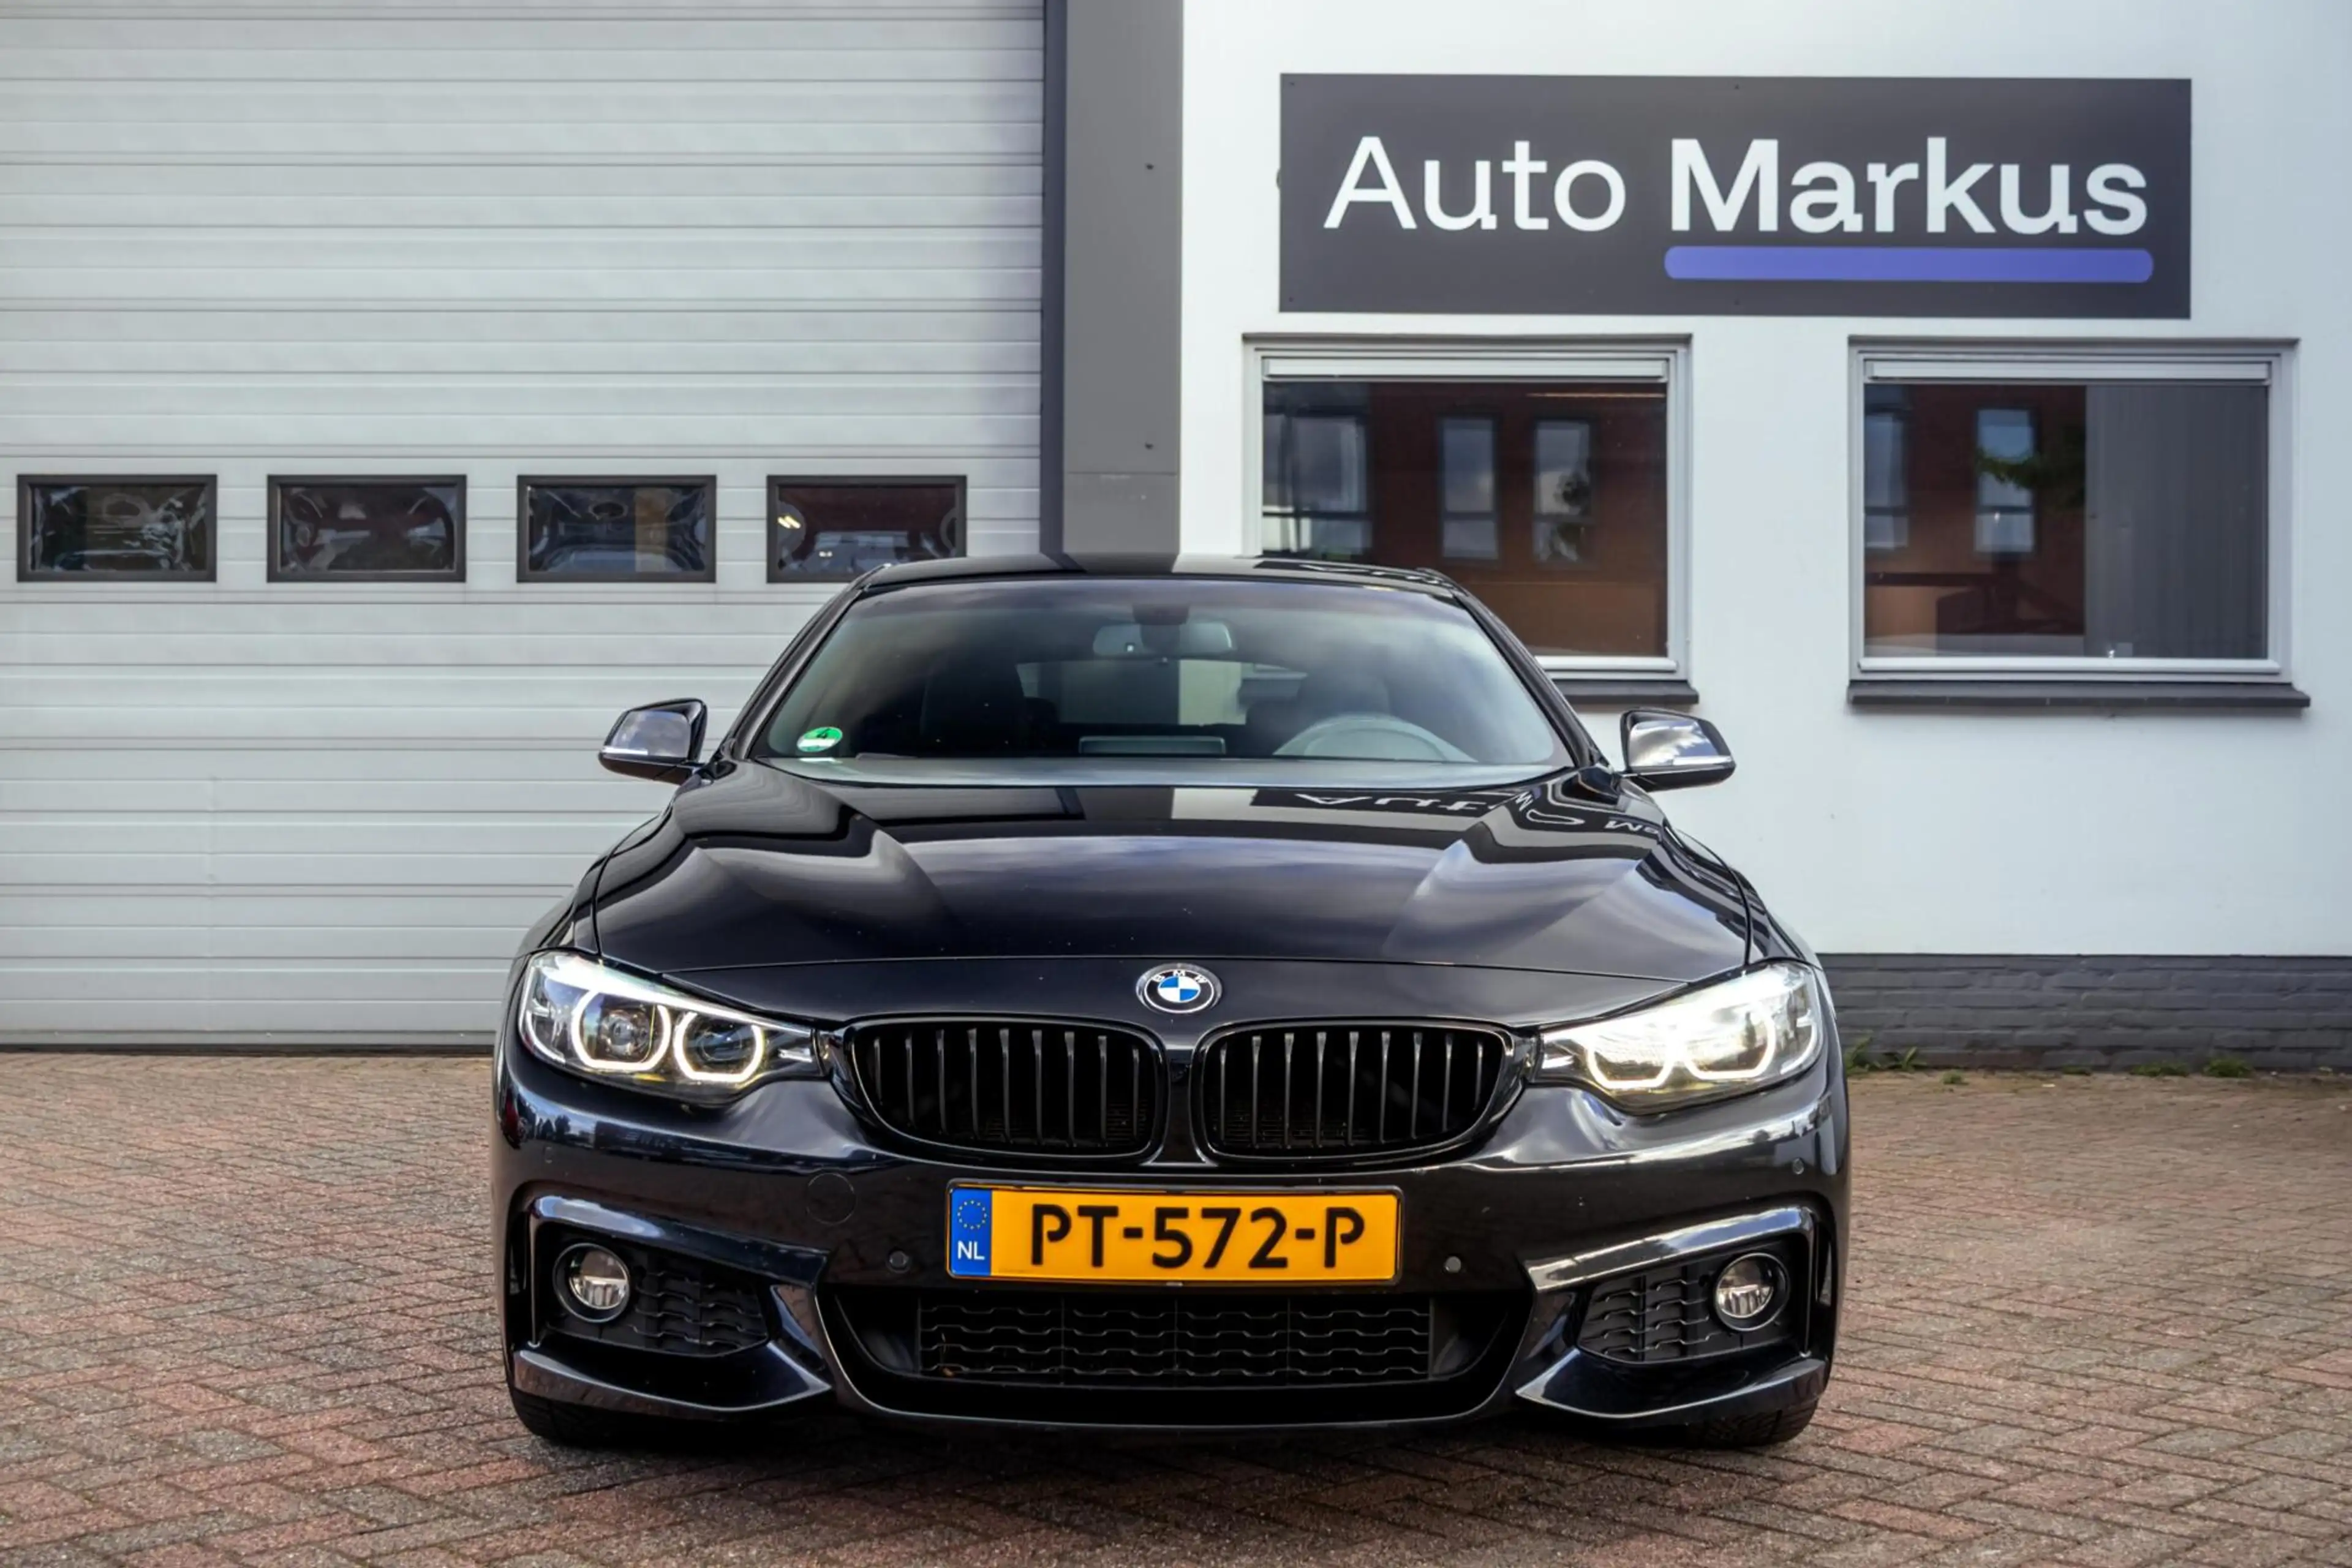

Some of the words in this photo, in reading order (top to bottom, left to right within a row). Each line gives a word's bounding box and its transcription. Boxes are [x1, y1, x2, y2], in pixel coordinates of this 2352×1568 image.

[1323, 136, 1626, 231] Auto
[1671, 137, 2147, 234] Markus
[1151, 970, 1208, 984] BMW
[957, 1240, 985, 1260] NL
[1031, 1203, 1365, 1269] PT-572-P
